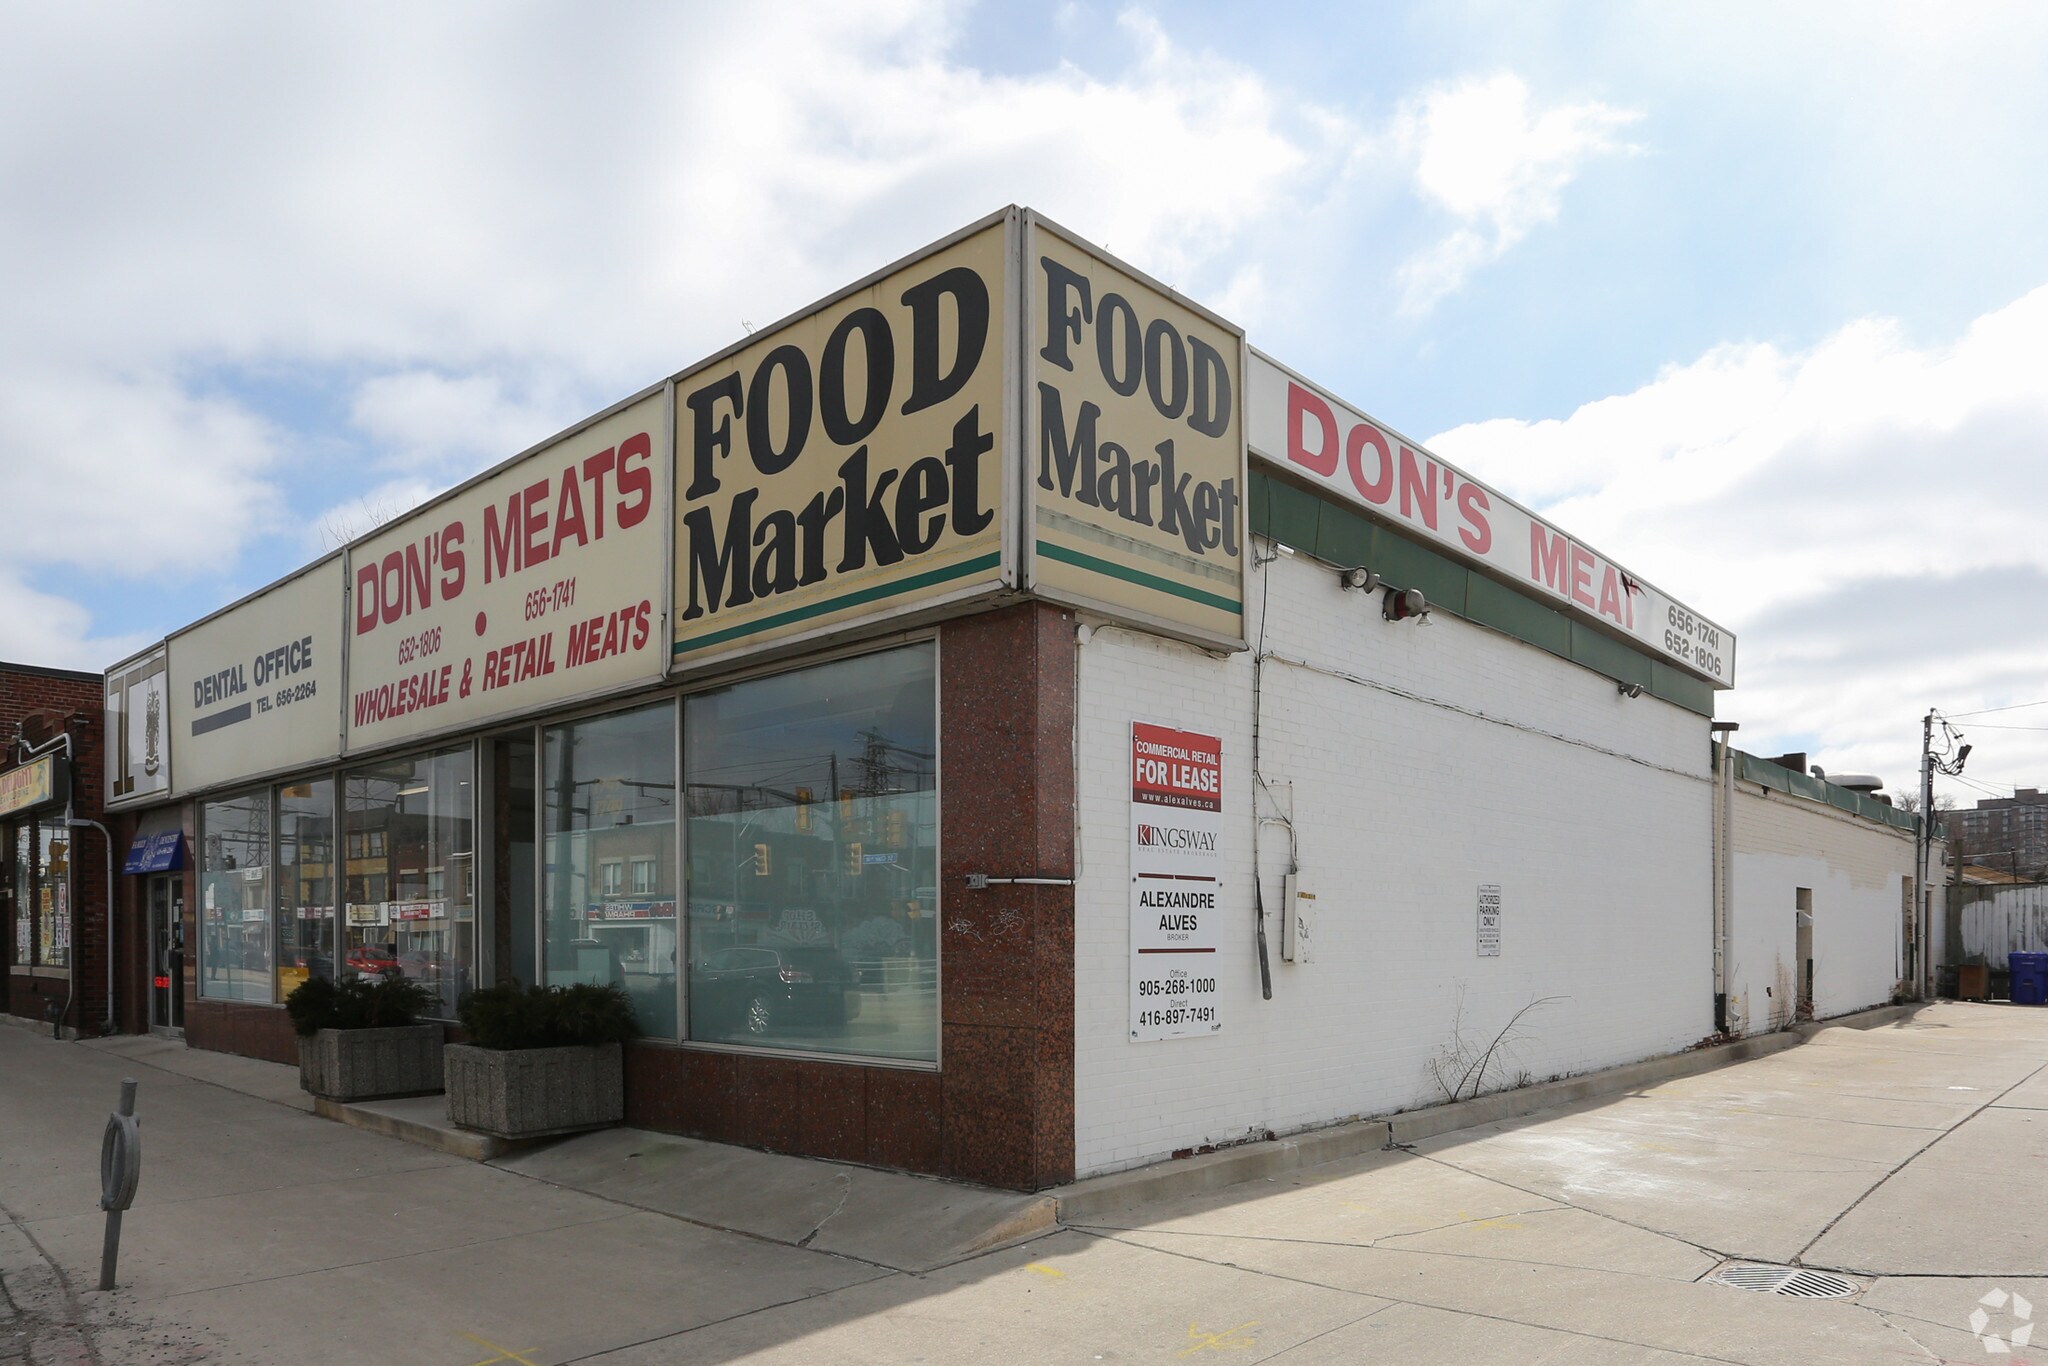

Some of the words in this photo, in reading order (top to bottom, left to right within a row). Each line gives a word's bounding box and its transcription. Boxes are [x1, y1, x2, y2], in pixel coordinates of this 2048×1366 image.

[1040, 256, 1232, 438] FOOD
[686, 267, 990, 501] FOOD
[1037, 381, 1238, 557] Market
[1287, 380, 1492, 555] DON'S
[682, 403, 994, 621] Market
[357, 521, 466, 636] DON'S
[484, 432, 651, 584] MEATS
[525, 576, 576, 621] 656-1741
[398, 626, 442, 665] 652-1806
[194, 664, 247, 709] DENTAL
[254, 635, 312, 687] OFFICE
[354, 664, 452, 727] WHOLESALE
[459, 658, 472, 699] &
[482, 632, 555, 691] RETAIL
[566, 600, 651, 668] MEATS
[276, 680, 316, 707] 656-2264
[1136, 740, 1191, 760] COMMERCIAL
[1192, 751, 1218, 765] RETAIL
[1136, 758, 1168, 786] FOR
[1172, 764, 1218, 793] LEASE
[1142, 793, 1214, 809] www.alexalves.ca
[1138, 824, 1218, 851] KINGSWAY
[1140, 891, 1215, 908] ALEXANDRE
[1479, 905, 1499, 915] PARKING
[1159, 914, 1197, 931] ALVES
[1483, 916, 1496, 926] ONLY
[1167, 933, 1189, 941] BROKER
[1139, 978, 1216, 996] 905-268-1000
[1169, 969, 1188, 978] Office
[1140, 1007, 1215, 1026] 416-897-7491
[1170, 999, 1188, 1008] Direct
